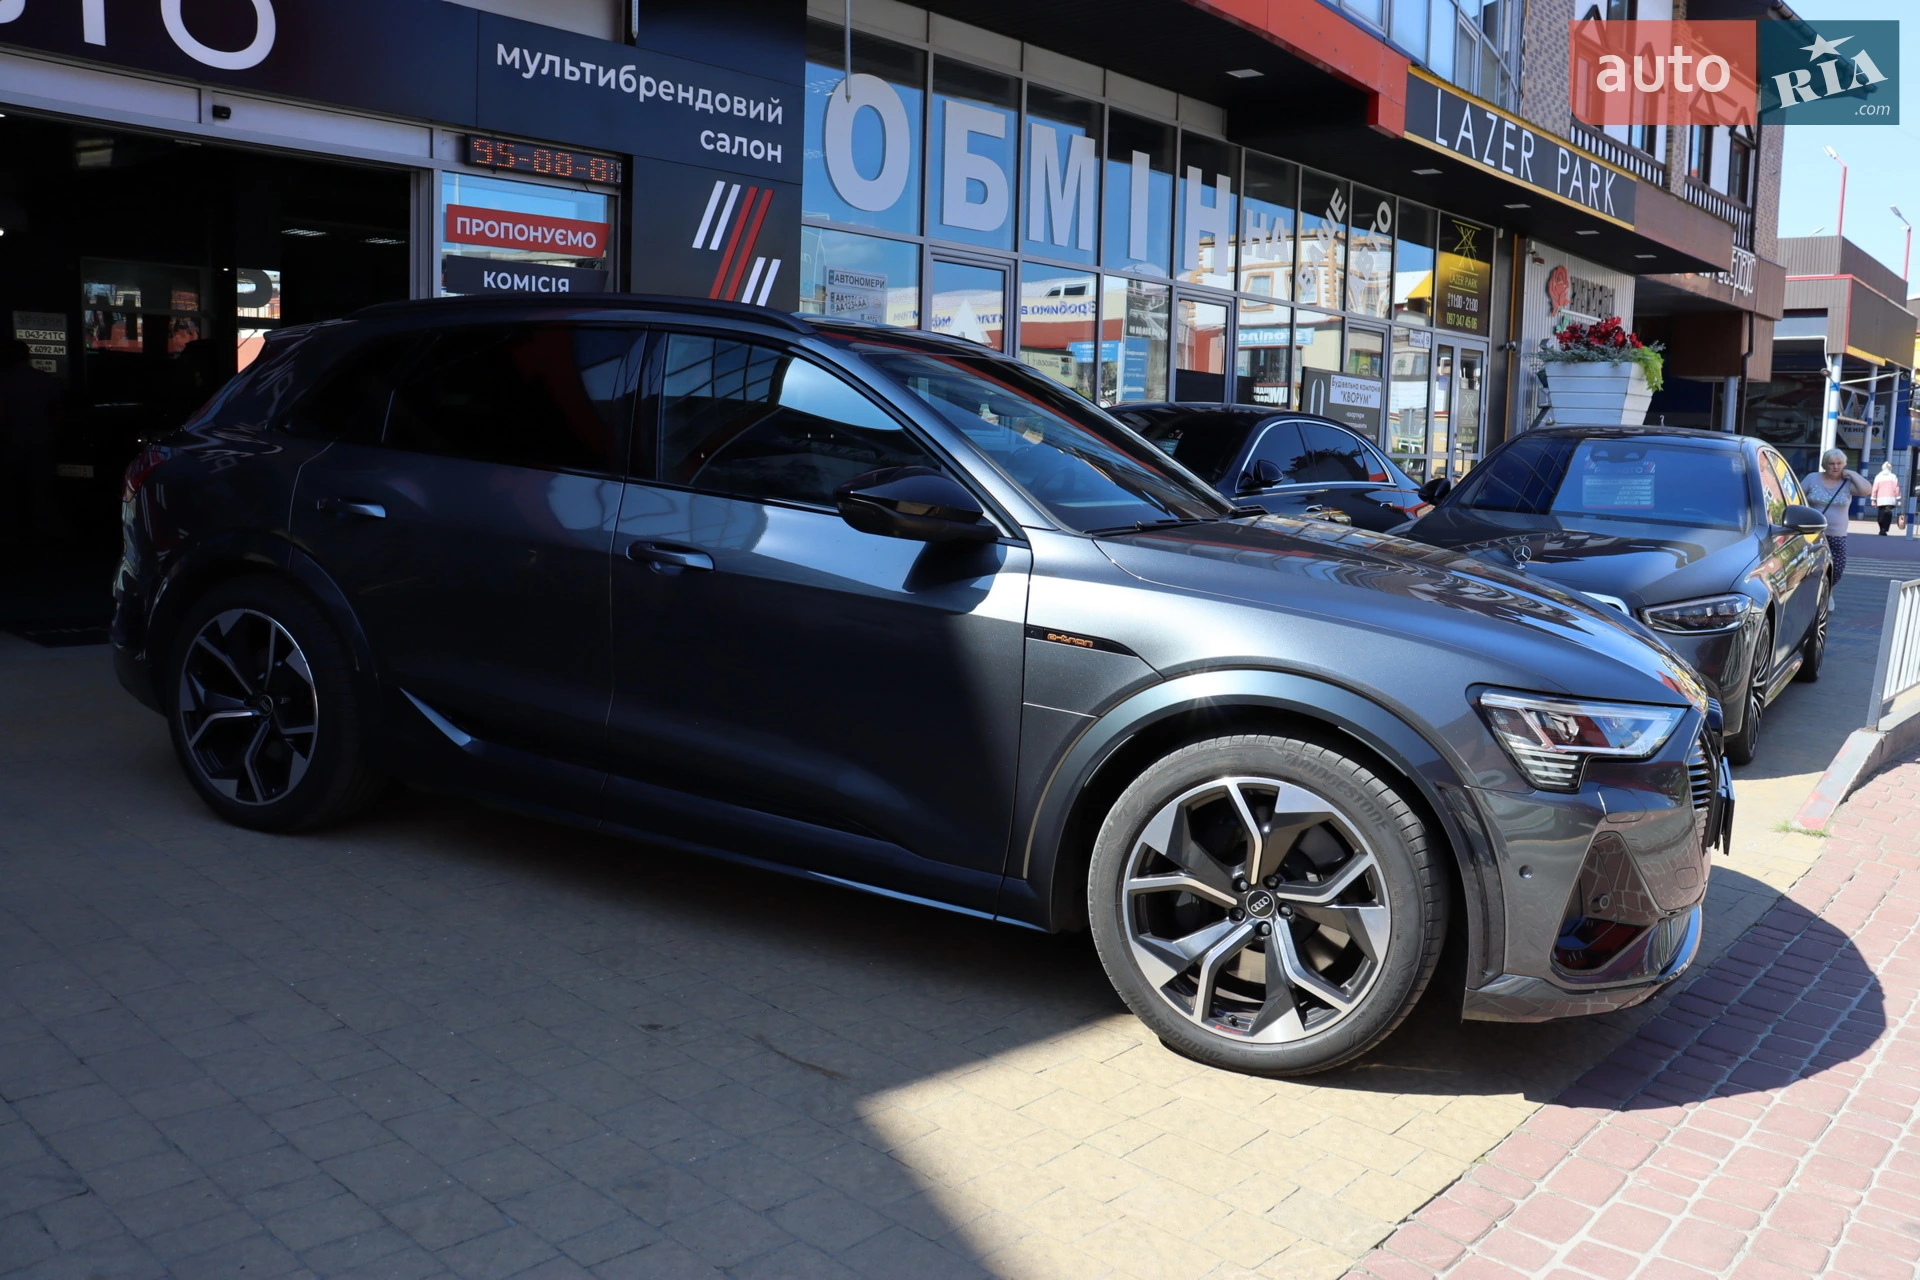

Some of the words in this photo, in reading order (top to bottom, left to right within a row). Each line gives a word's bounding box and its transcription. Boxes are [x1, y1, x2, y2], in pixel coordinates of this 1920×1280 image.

[496, 43, 784, 125] мультибрендовий
[700, 129, 783, 163] салон
[1435, 89, 1535, 183] LAZER
[1557, 146, 1617, 217] PARK
[824, 73, 1233, 277] ОБМІН
[456, 217, 597, 250] ПРОПОНУЄМО
[1244, 209, 1291, 265] НА
[1299, 188, 1347, 299] ВАШЕ
[1348, 201, 1392, 317] АВТО
[483, 270, 570, 293] КОМІСІЯ
[834, 273, 885, 289] АВТОНОМЕРИ
[1341, 391, 1372, 404] "КВОРУМ"
